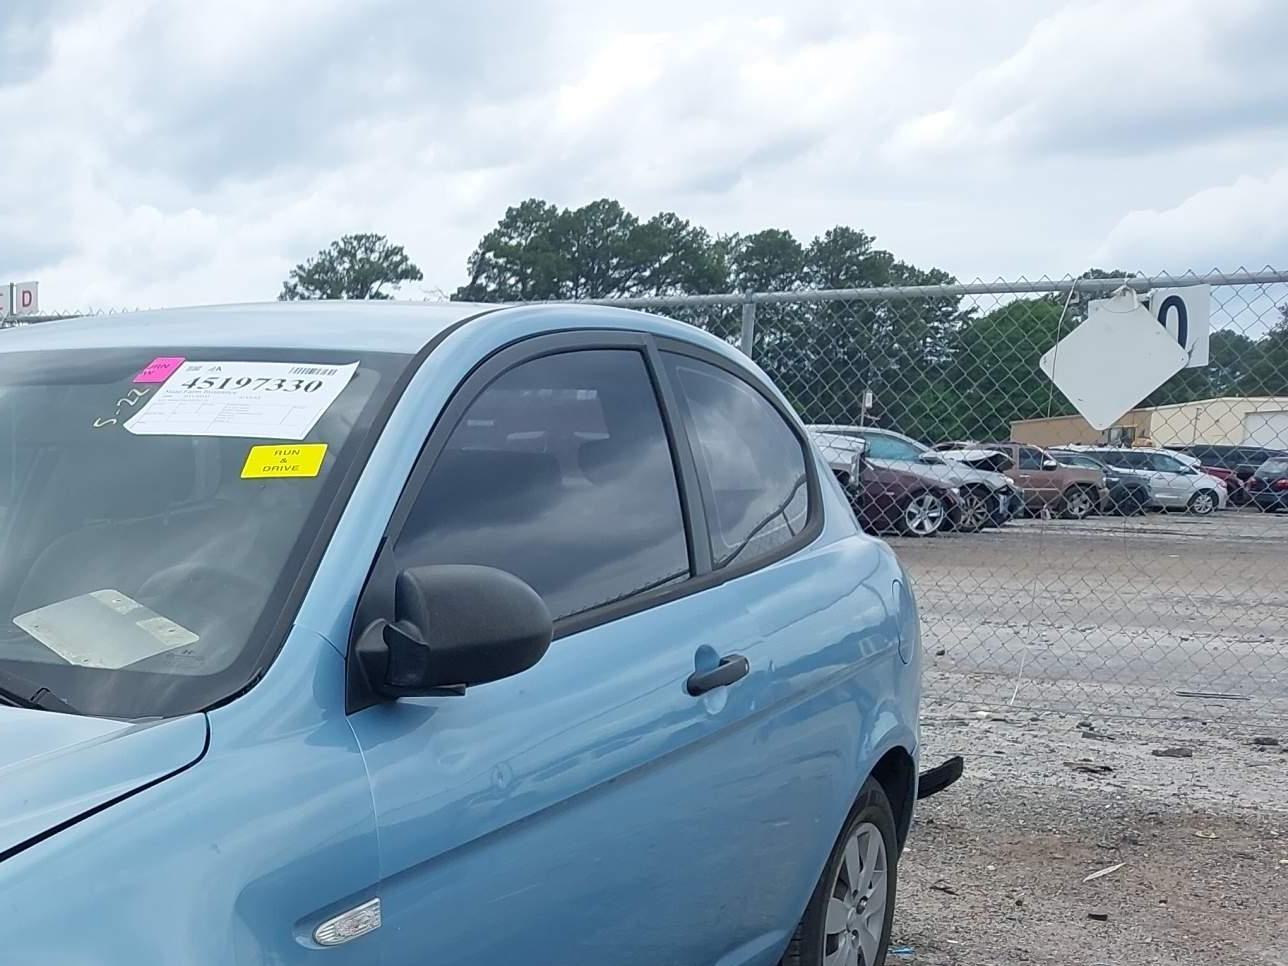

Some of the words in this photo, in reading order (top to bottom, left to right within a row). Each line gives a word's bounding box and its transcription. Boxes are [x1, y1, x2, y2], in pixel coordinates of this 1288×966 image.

[22, 290, 33, 308] D
[181, 376, 324, 394] 45197330
[262, 464, 300, 472] DRIVE
